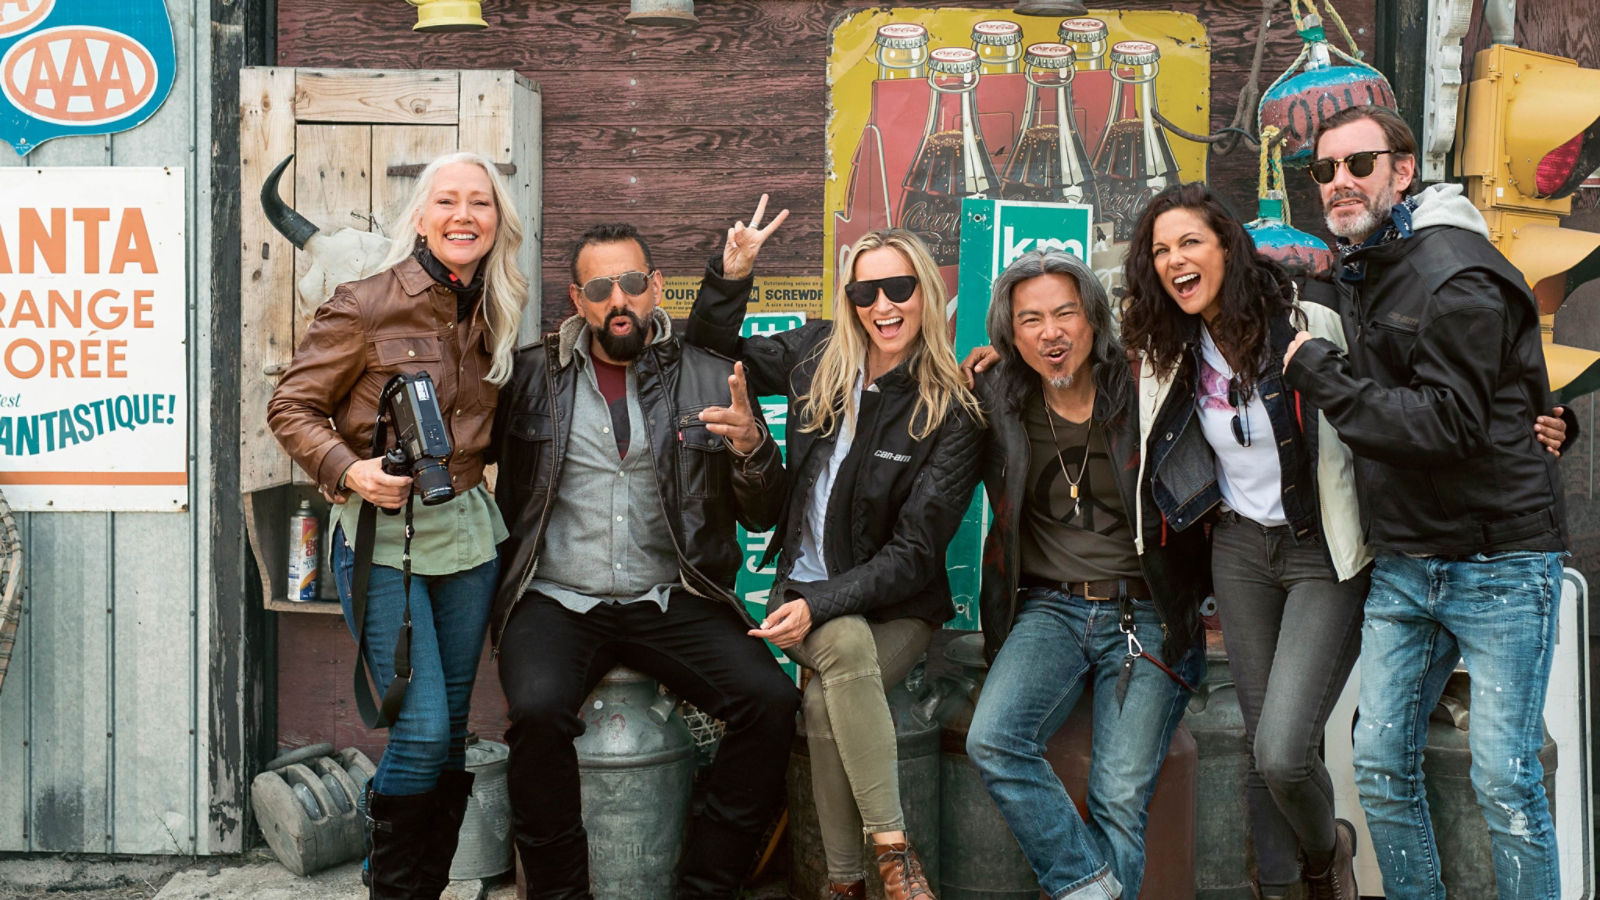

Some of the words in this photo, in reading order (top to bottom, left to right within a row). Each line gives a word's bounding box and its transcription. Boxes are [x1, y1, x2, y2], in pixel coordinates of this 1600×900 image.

[24, 36, 137, 114] AAA
[0, 208, 158, 274] NTA
[0, 288, 154, 330] ANGE
[662, 288, 701, 301] OUR
[4, 330, 128, 379] ORÉE
[874, 449, 912, 463] can-am
